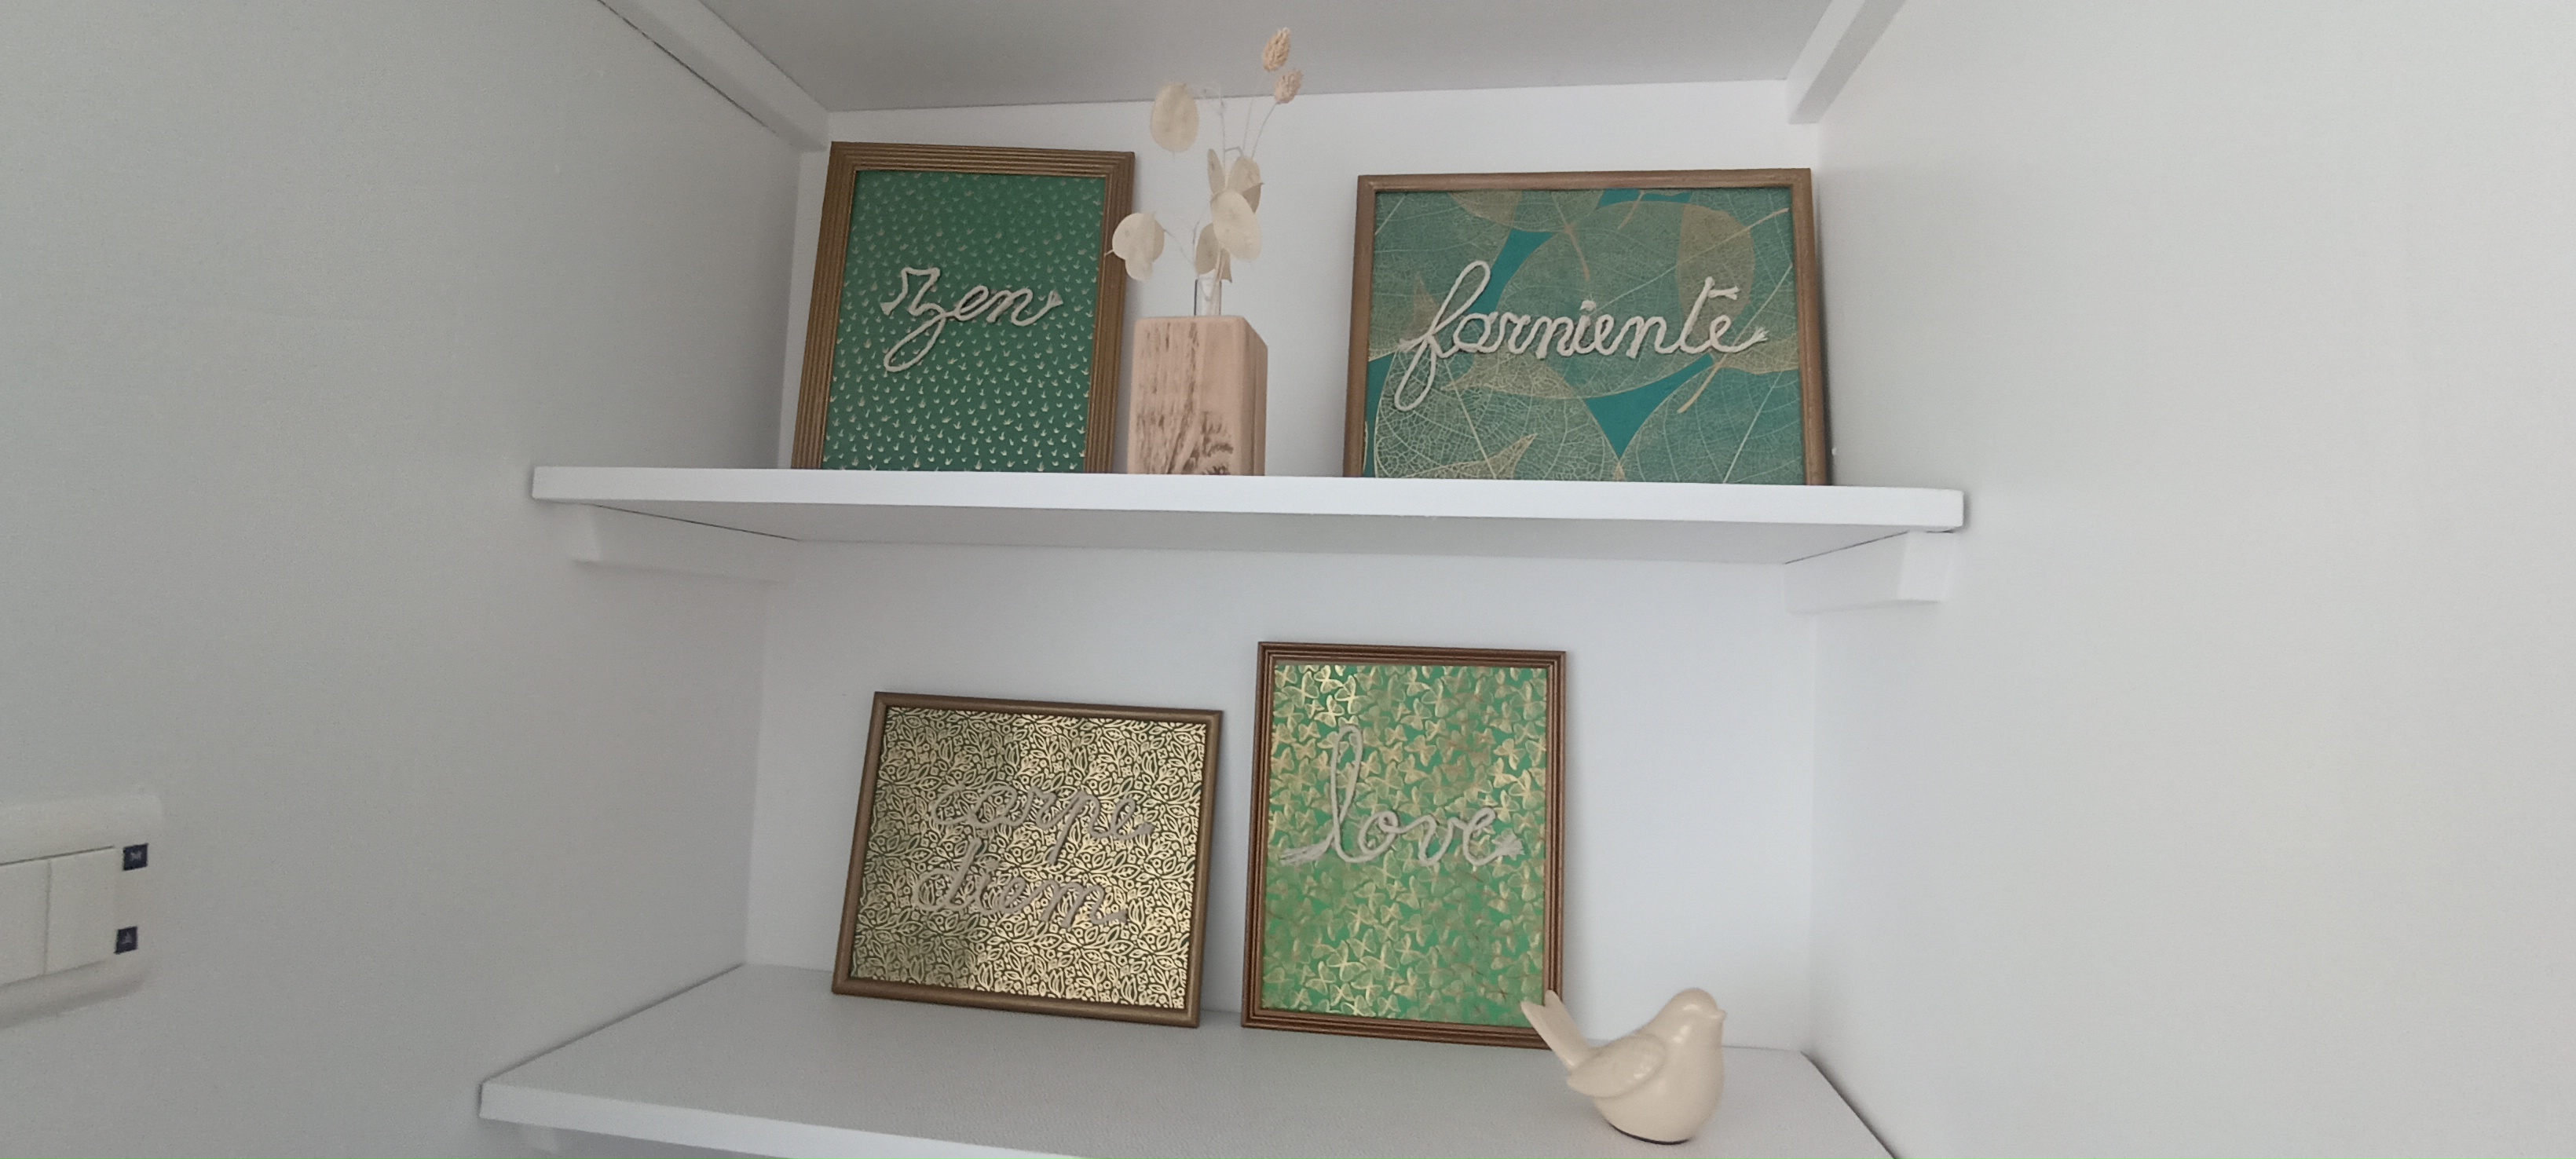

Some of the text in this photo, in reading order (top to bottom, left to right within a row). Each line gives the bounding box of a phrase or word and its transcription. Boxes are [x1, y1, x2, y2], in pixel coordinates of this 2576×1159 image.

[880, 267, 1063, 372] zen
[1394, 260, 1768, 411] farniente
[930, 785, 1155, 865] carpe
[1279, 724, 1524, 865] love
[912, 837, 1129, 929] diem
